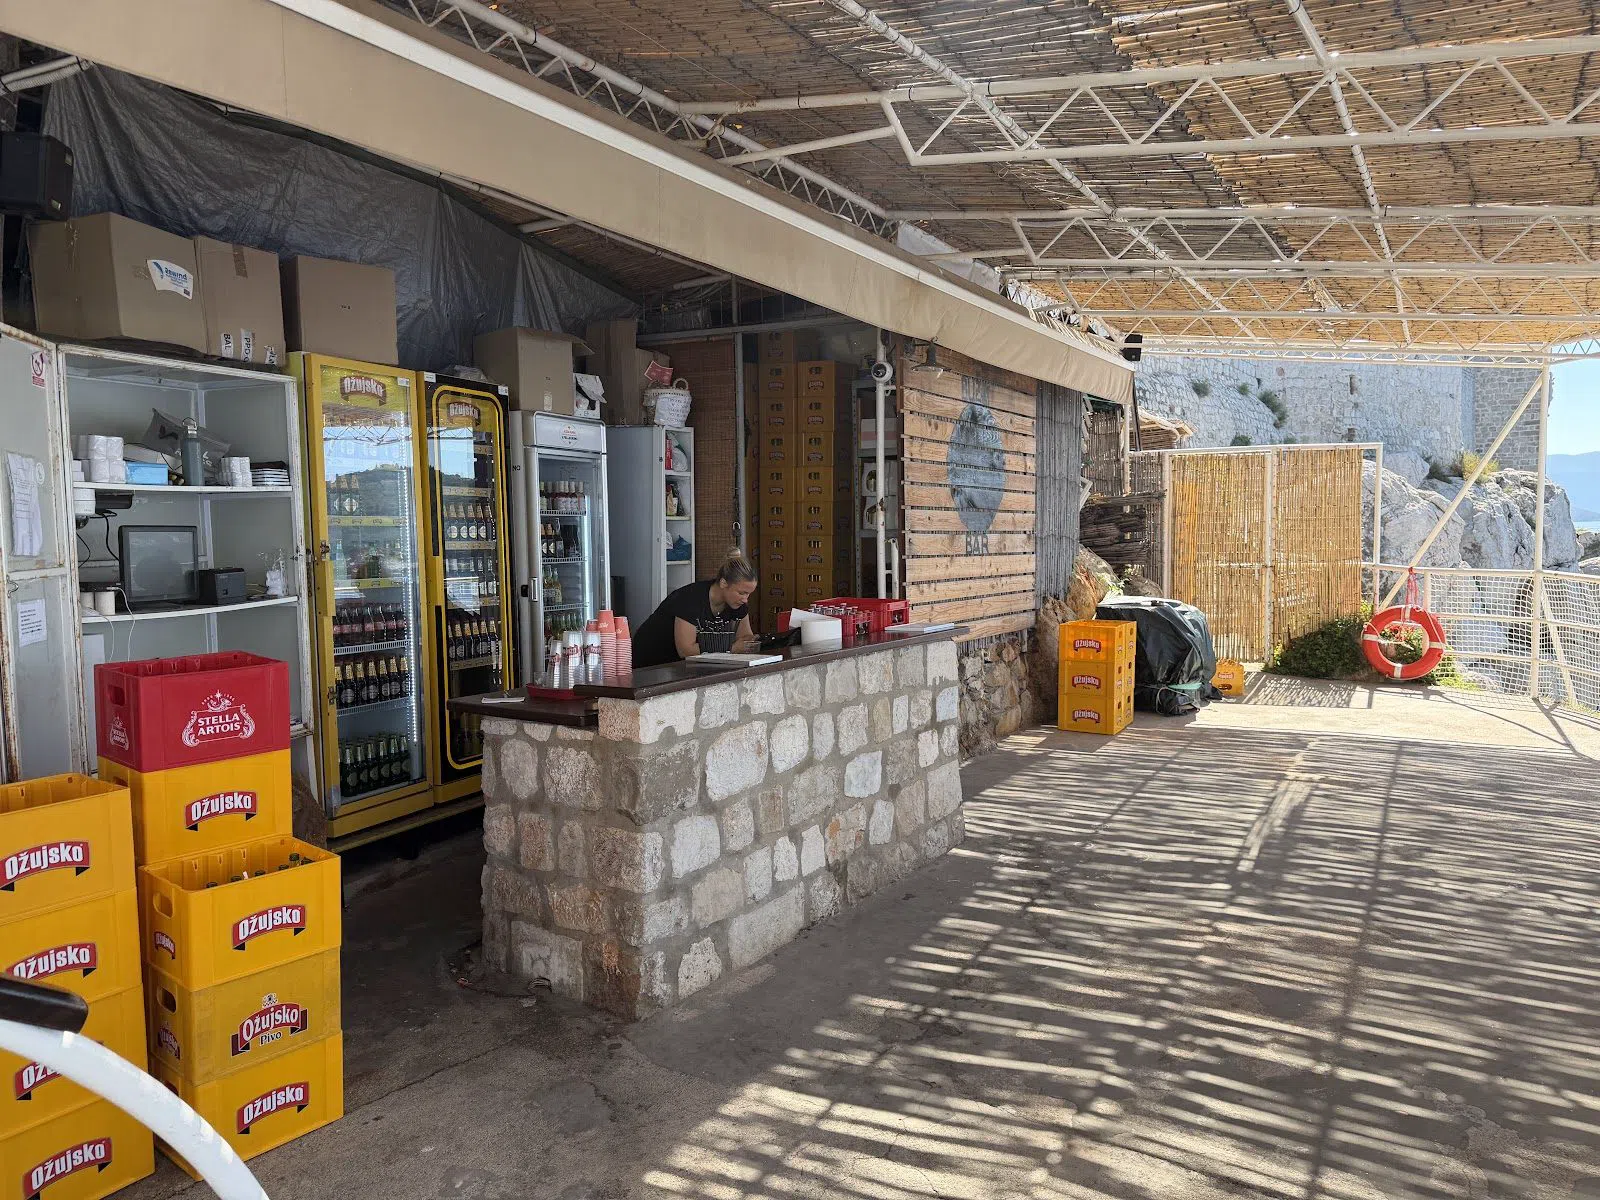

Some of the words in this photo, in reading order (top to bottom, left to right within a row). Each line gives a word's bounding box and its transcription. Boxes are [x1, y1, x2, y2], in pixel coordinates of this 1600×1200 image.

[966, 532, 989, 555] BAR
[198, 713, 240, 727] STELLA
[198, 722, 242, 736] ARTOIS
[191, 792, 252, 822] Ožujsko
[5, 843, 84, 880] Ožujsko
[239, 906, 301, 941] Ožujsko
[242, 1004, 299, 1042] Ožujsko
[260, 1030, 282, 1045] Pivo
[243, 1086, 304, 1125] Ožujsko
[32, 1143, 105, 1190] Ožujsko
